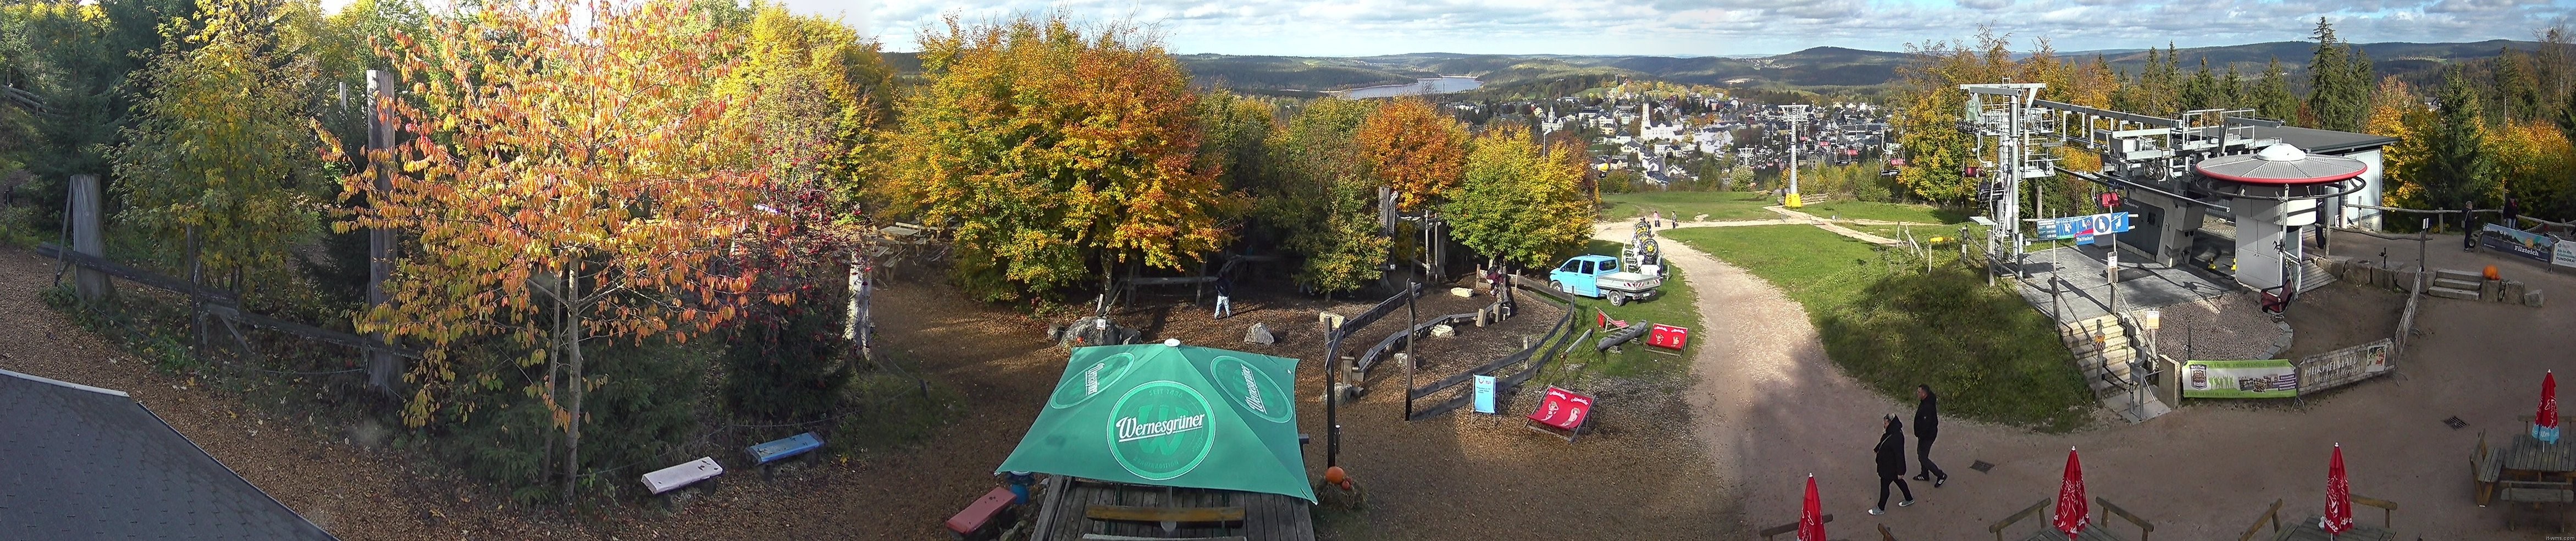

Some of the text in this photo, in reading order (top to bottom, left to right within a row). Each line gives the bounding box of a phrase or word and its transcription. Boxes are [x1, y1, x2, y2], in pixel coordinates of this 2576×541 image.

[2514, 245, 2539, 256] Filzteich
[2304, 355, 2359, 377] MURMELWALD
[1115, 413, 1206, 440] Wernesgrüner
